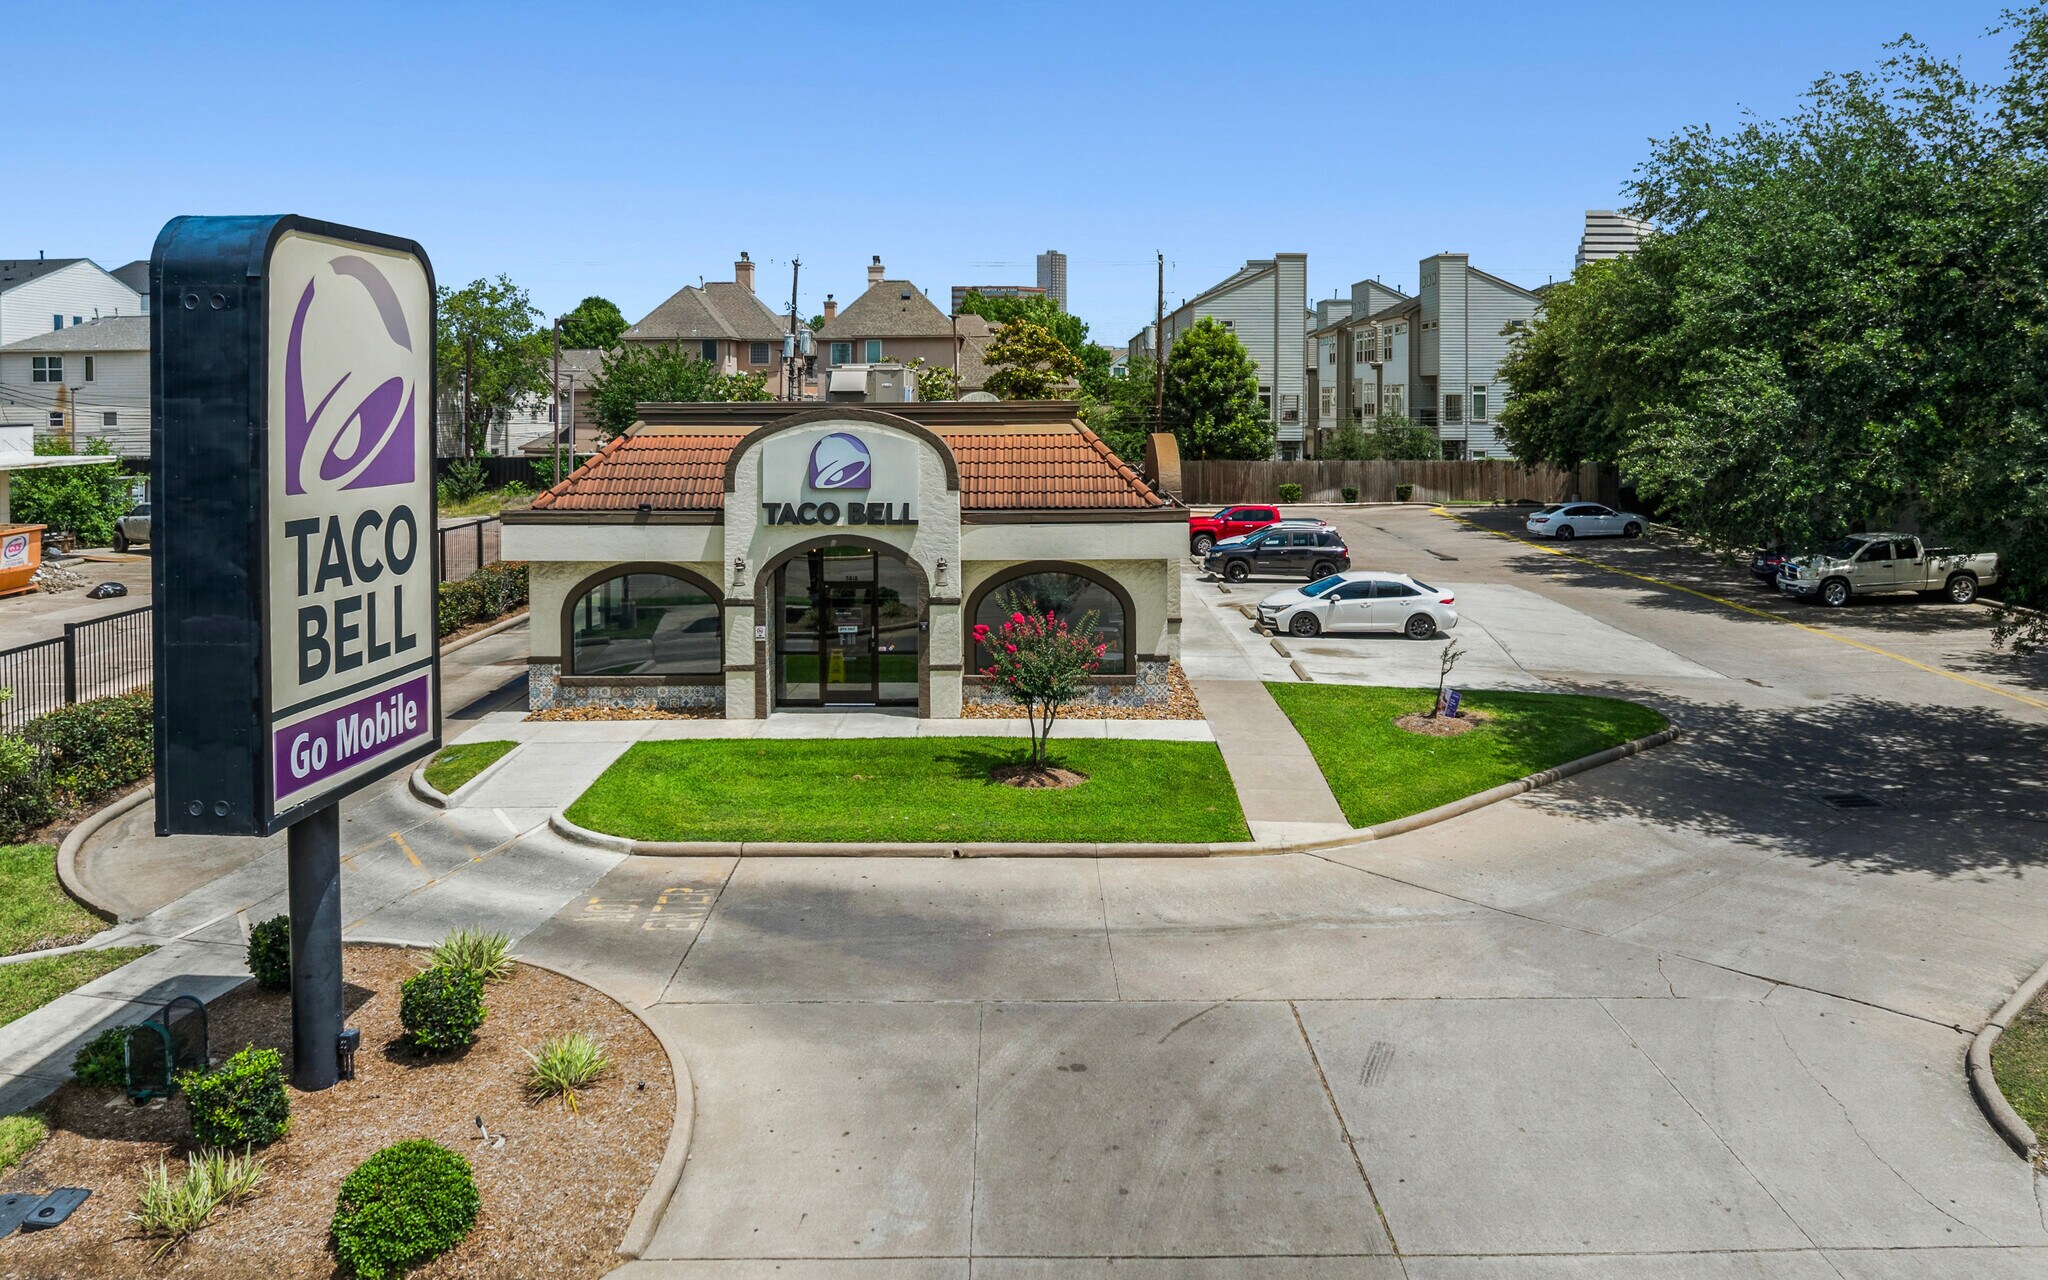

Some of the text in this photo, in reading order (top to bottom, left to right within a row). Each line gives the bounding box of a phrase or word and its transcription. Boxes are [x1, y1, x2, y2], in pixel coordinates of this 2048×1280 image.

[285, 504, 418, 597] TACO
[762, 502, 919, 526] TACO BELL
[298, 585, 417, 686] BELL
[290, 691, 418, 780] Go Mobile
[641, 887, 716, 931] ENTER
